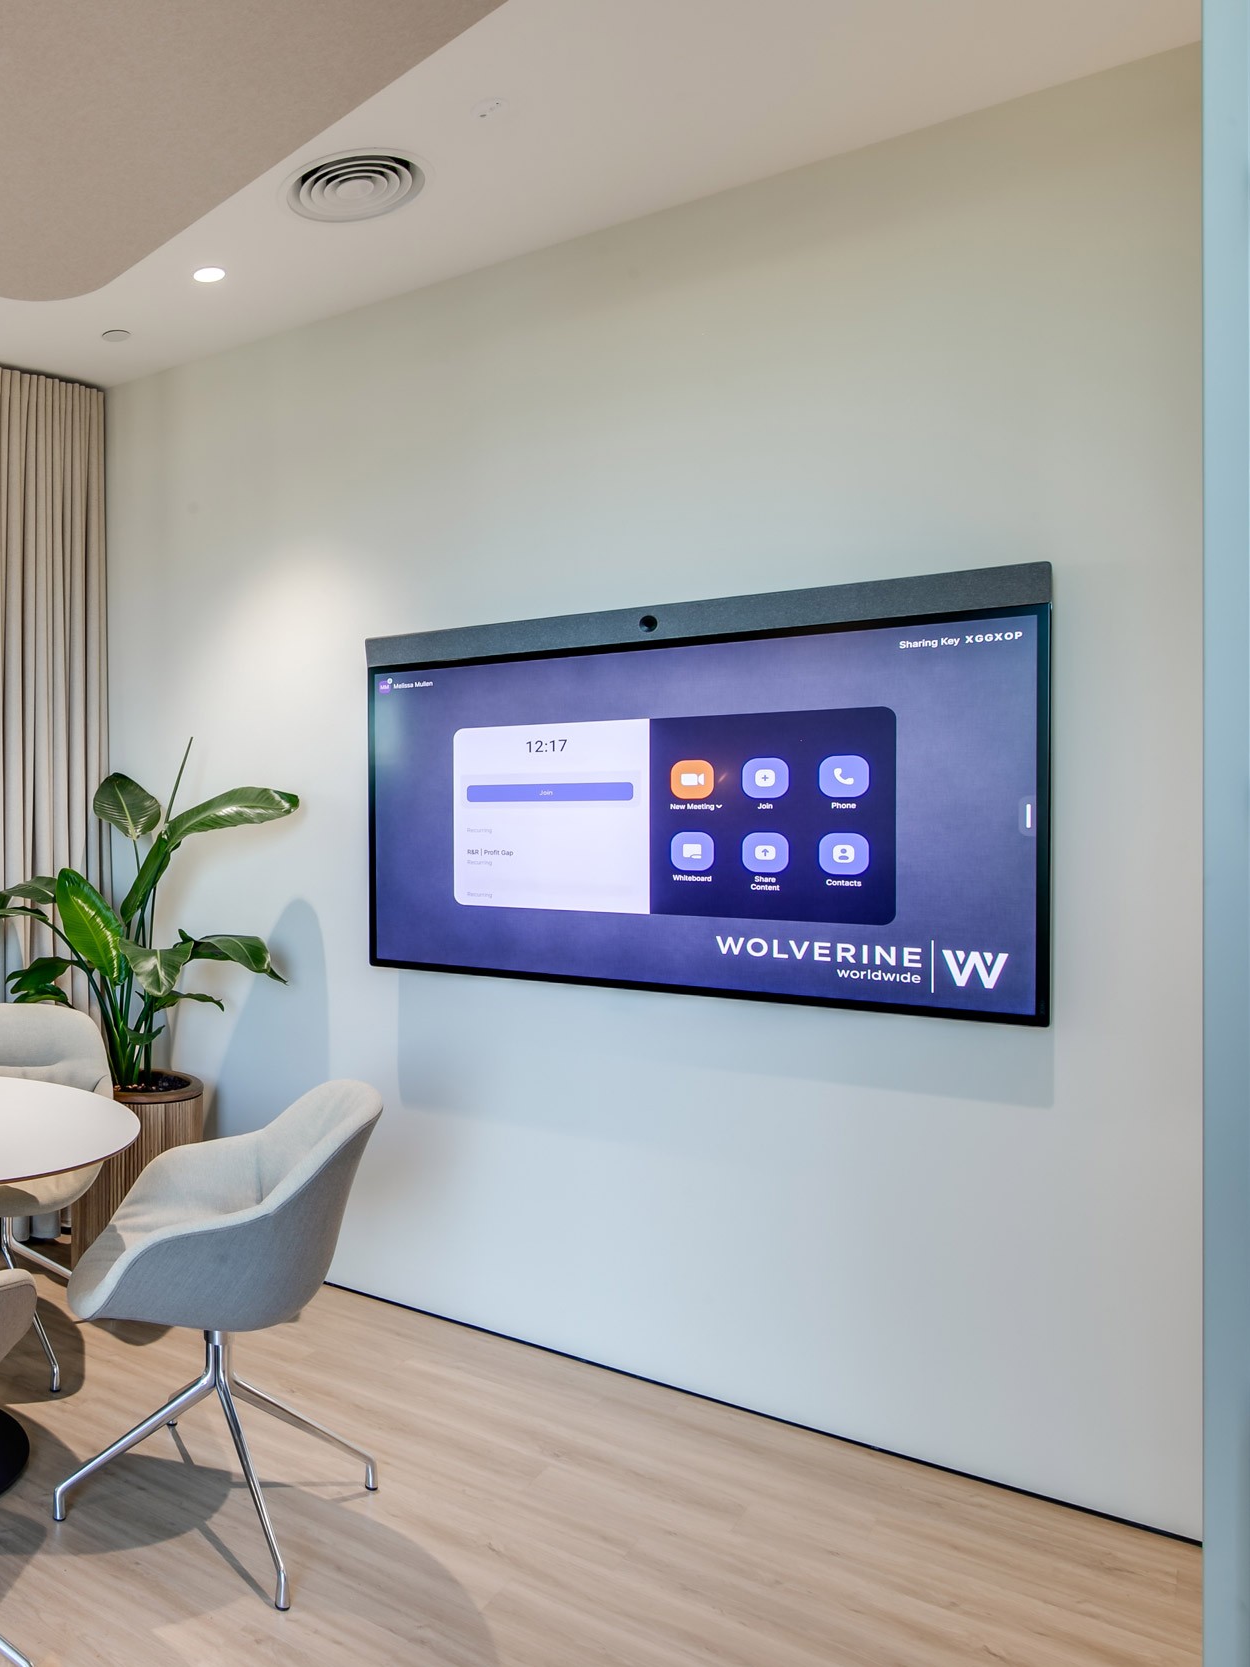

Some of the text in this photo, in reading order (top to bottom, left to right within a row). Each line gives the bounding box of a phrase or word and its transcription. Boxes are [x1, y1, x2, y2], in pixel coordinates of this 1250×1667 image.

[899, 631, 1024, 649] Sharing Key XGGXOP
[526, 739, 568, 753] 12:17
[686, 803, 715, 811] Meeting
[757, 802, 773, 810] Join
[831, 802, 856, 810] Phone
[501, 849, 514, 857] Gap
[672, 874, 712, 882] Whiteboard
[754, 875, 776, 883] Share
[826, 878, 862, 887] Contacts
[750, 883, 780, 891] Content
[716, 935, 923, 968] WOLVERINE
[836, 968, 922, 984] worldwide
